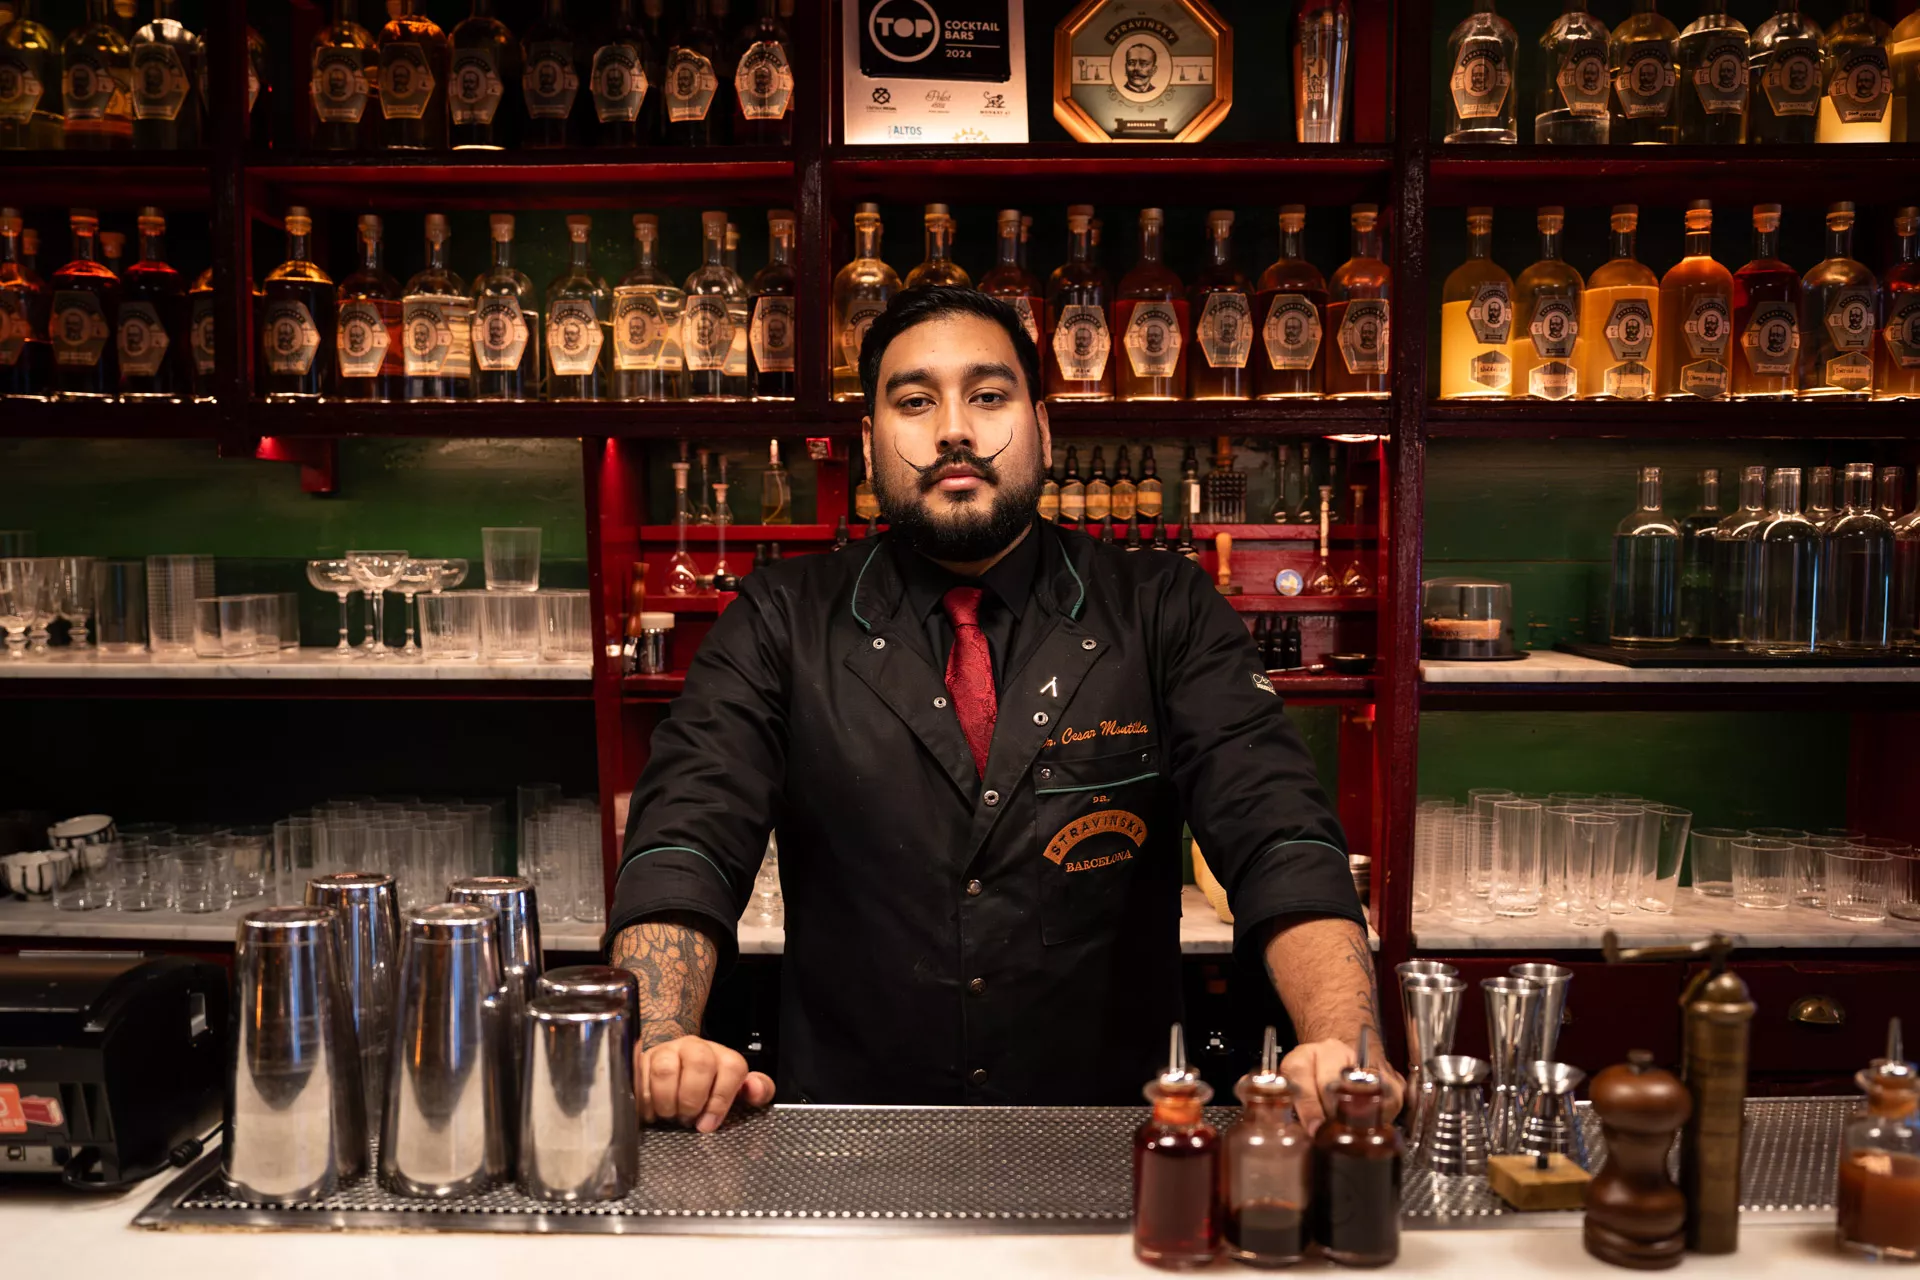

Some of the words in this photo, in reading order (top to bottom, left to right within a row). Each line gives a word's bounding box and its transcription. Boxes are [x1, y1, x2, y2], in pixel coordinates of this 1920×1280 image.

[876, 17, 932, 38] TOP
[945, 20, 1000, 32] COCKTAIL
[1108, 20, 1175, 41] STRAVINSKY
[945, 31, 975, 40] BARS
[946, 49, 972, 58] 2024
[893, 125, 923, 135] ALTOS
[1062, 727, 1097, 745] Cesar
[1051, 815, 1143, 856] STRAVINSKY
[1065, 849, 1134, 873] BARCELONA
